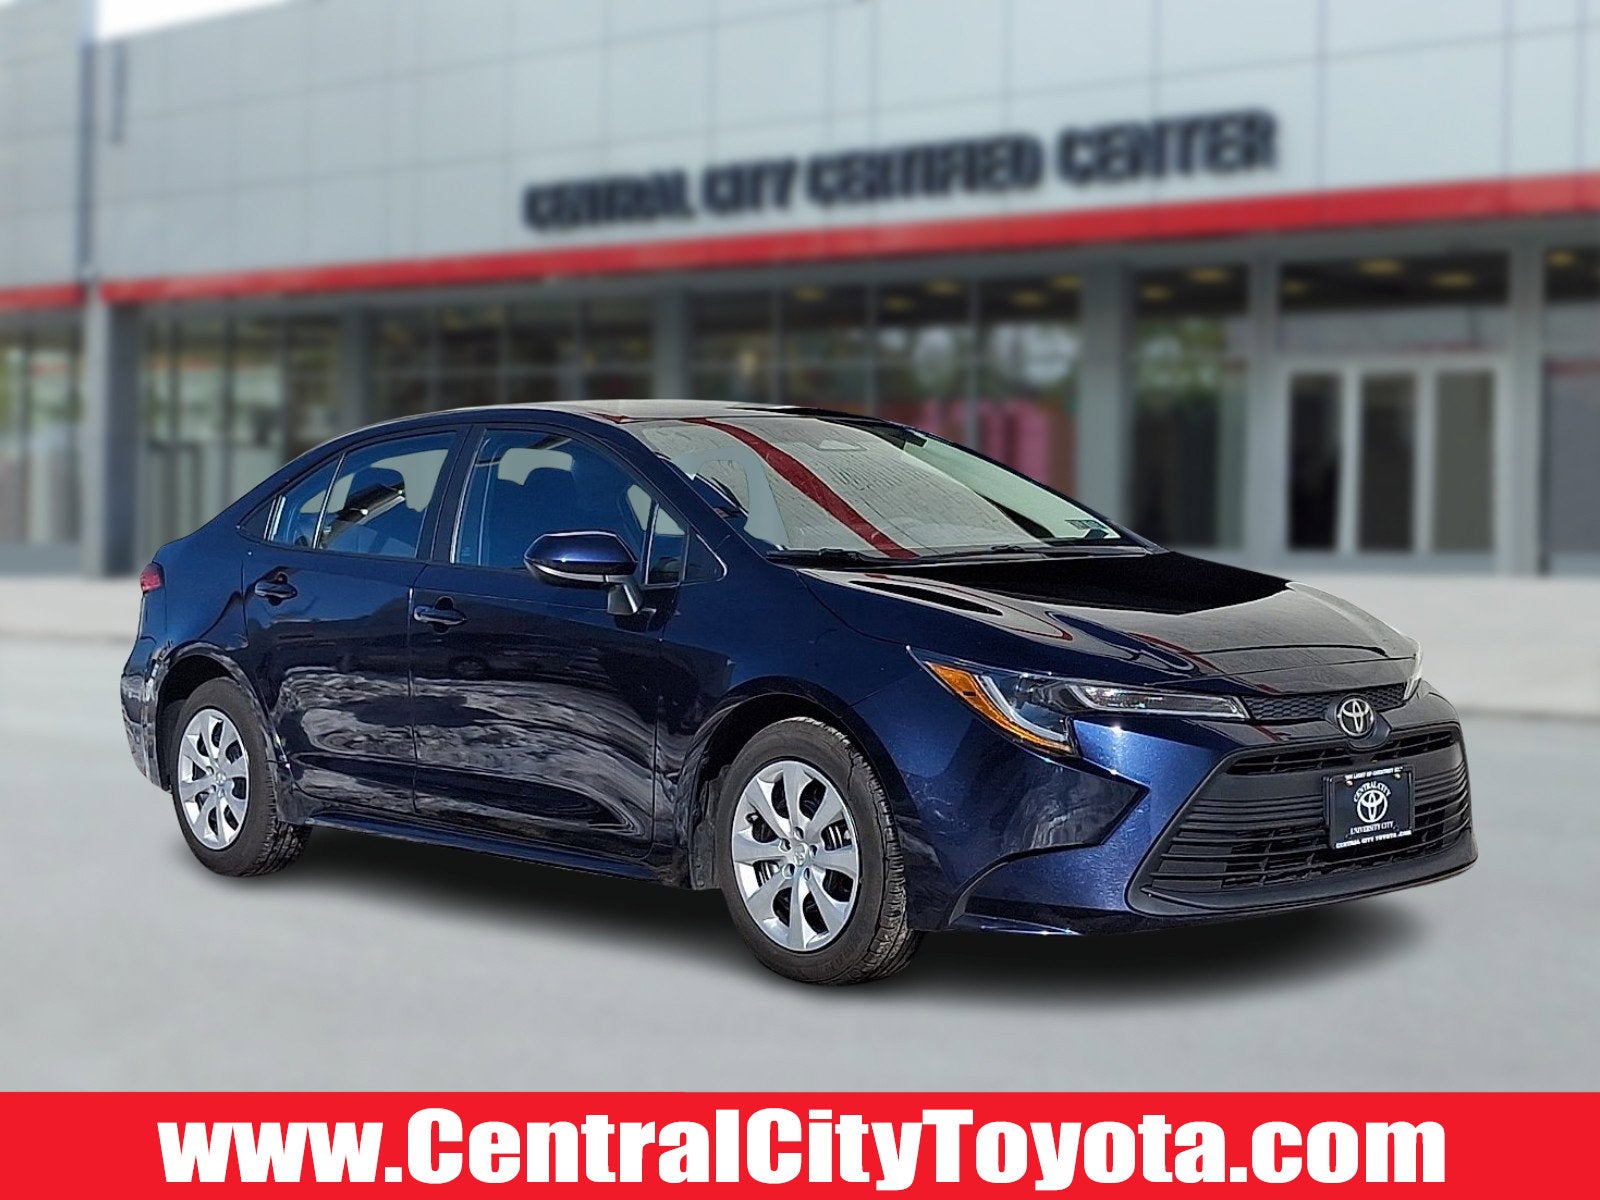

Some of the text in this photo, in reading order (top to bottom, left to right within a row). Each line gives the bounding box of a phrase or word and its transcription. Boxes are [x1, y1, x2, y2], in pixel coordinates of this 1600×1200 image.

[703, 157, 797, 216] CITY
[1058, 110, 1277, 188] CENTER
[1353, 781, 1392, 803] CENTRAL CITY
[1350, 820, 1394, 835] UNIVERSITY CITY
